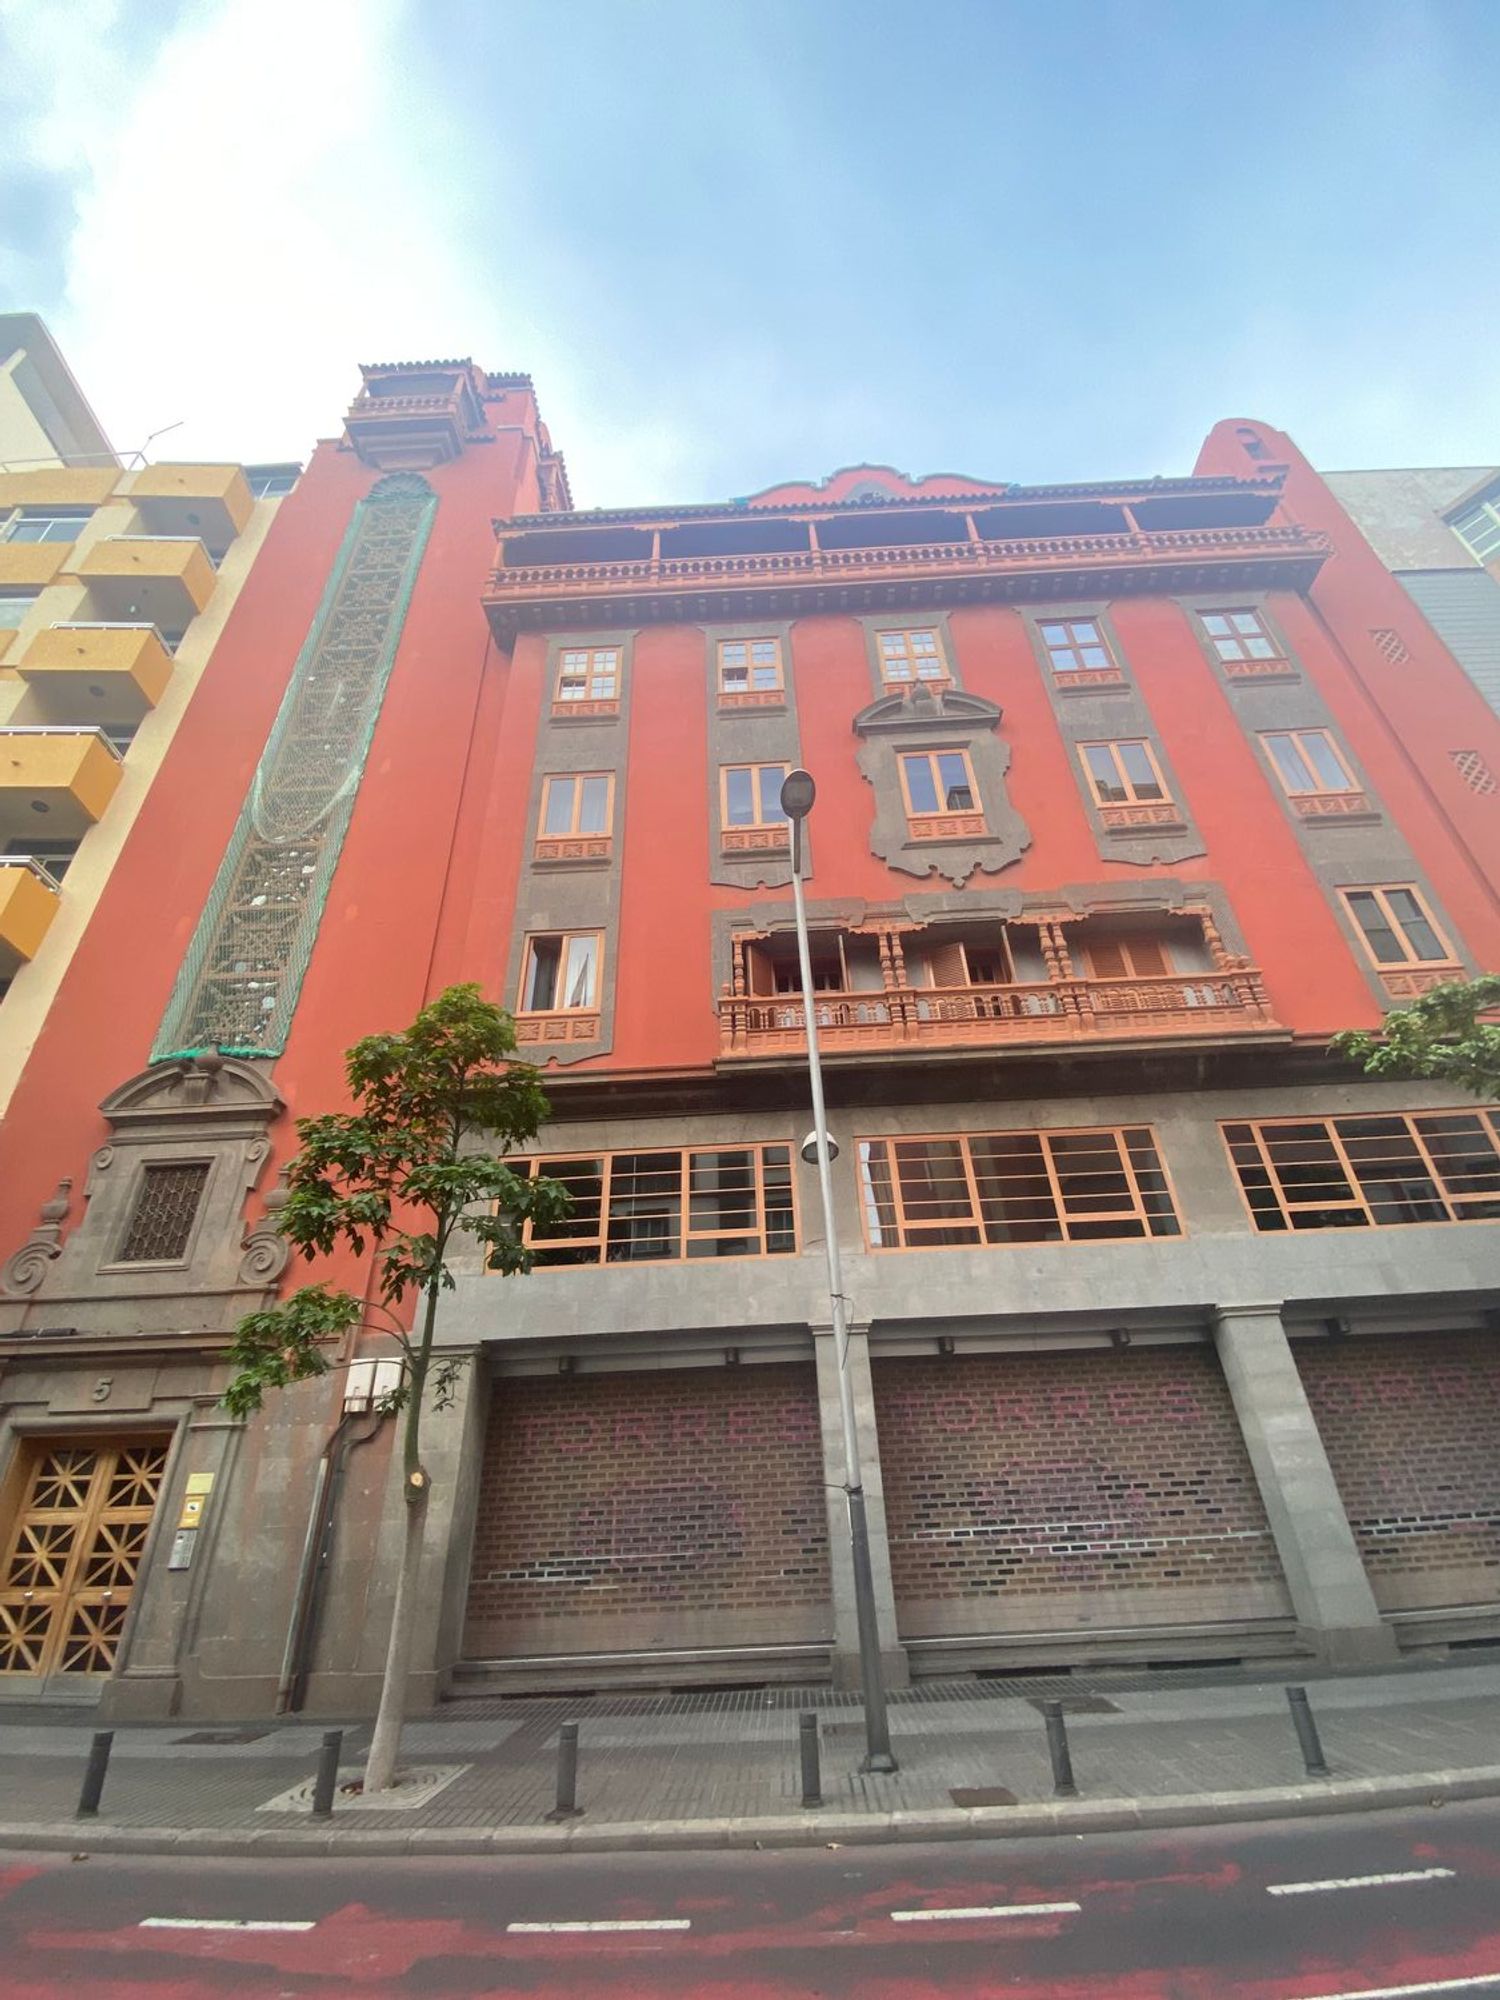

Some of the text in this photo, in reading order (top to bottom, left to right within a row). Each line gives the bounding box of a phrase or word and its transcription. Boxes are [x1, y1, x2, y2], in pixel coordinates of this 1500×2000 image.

[93, 1377, 112, 1402] 5
[889, 1381, 1202, 1431] TORRES
[519, 1403, 822, 1453] TORRES
